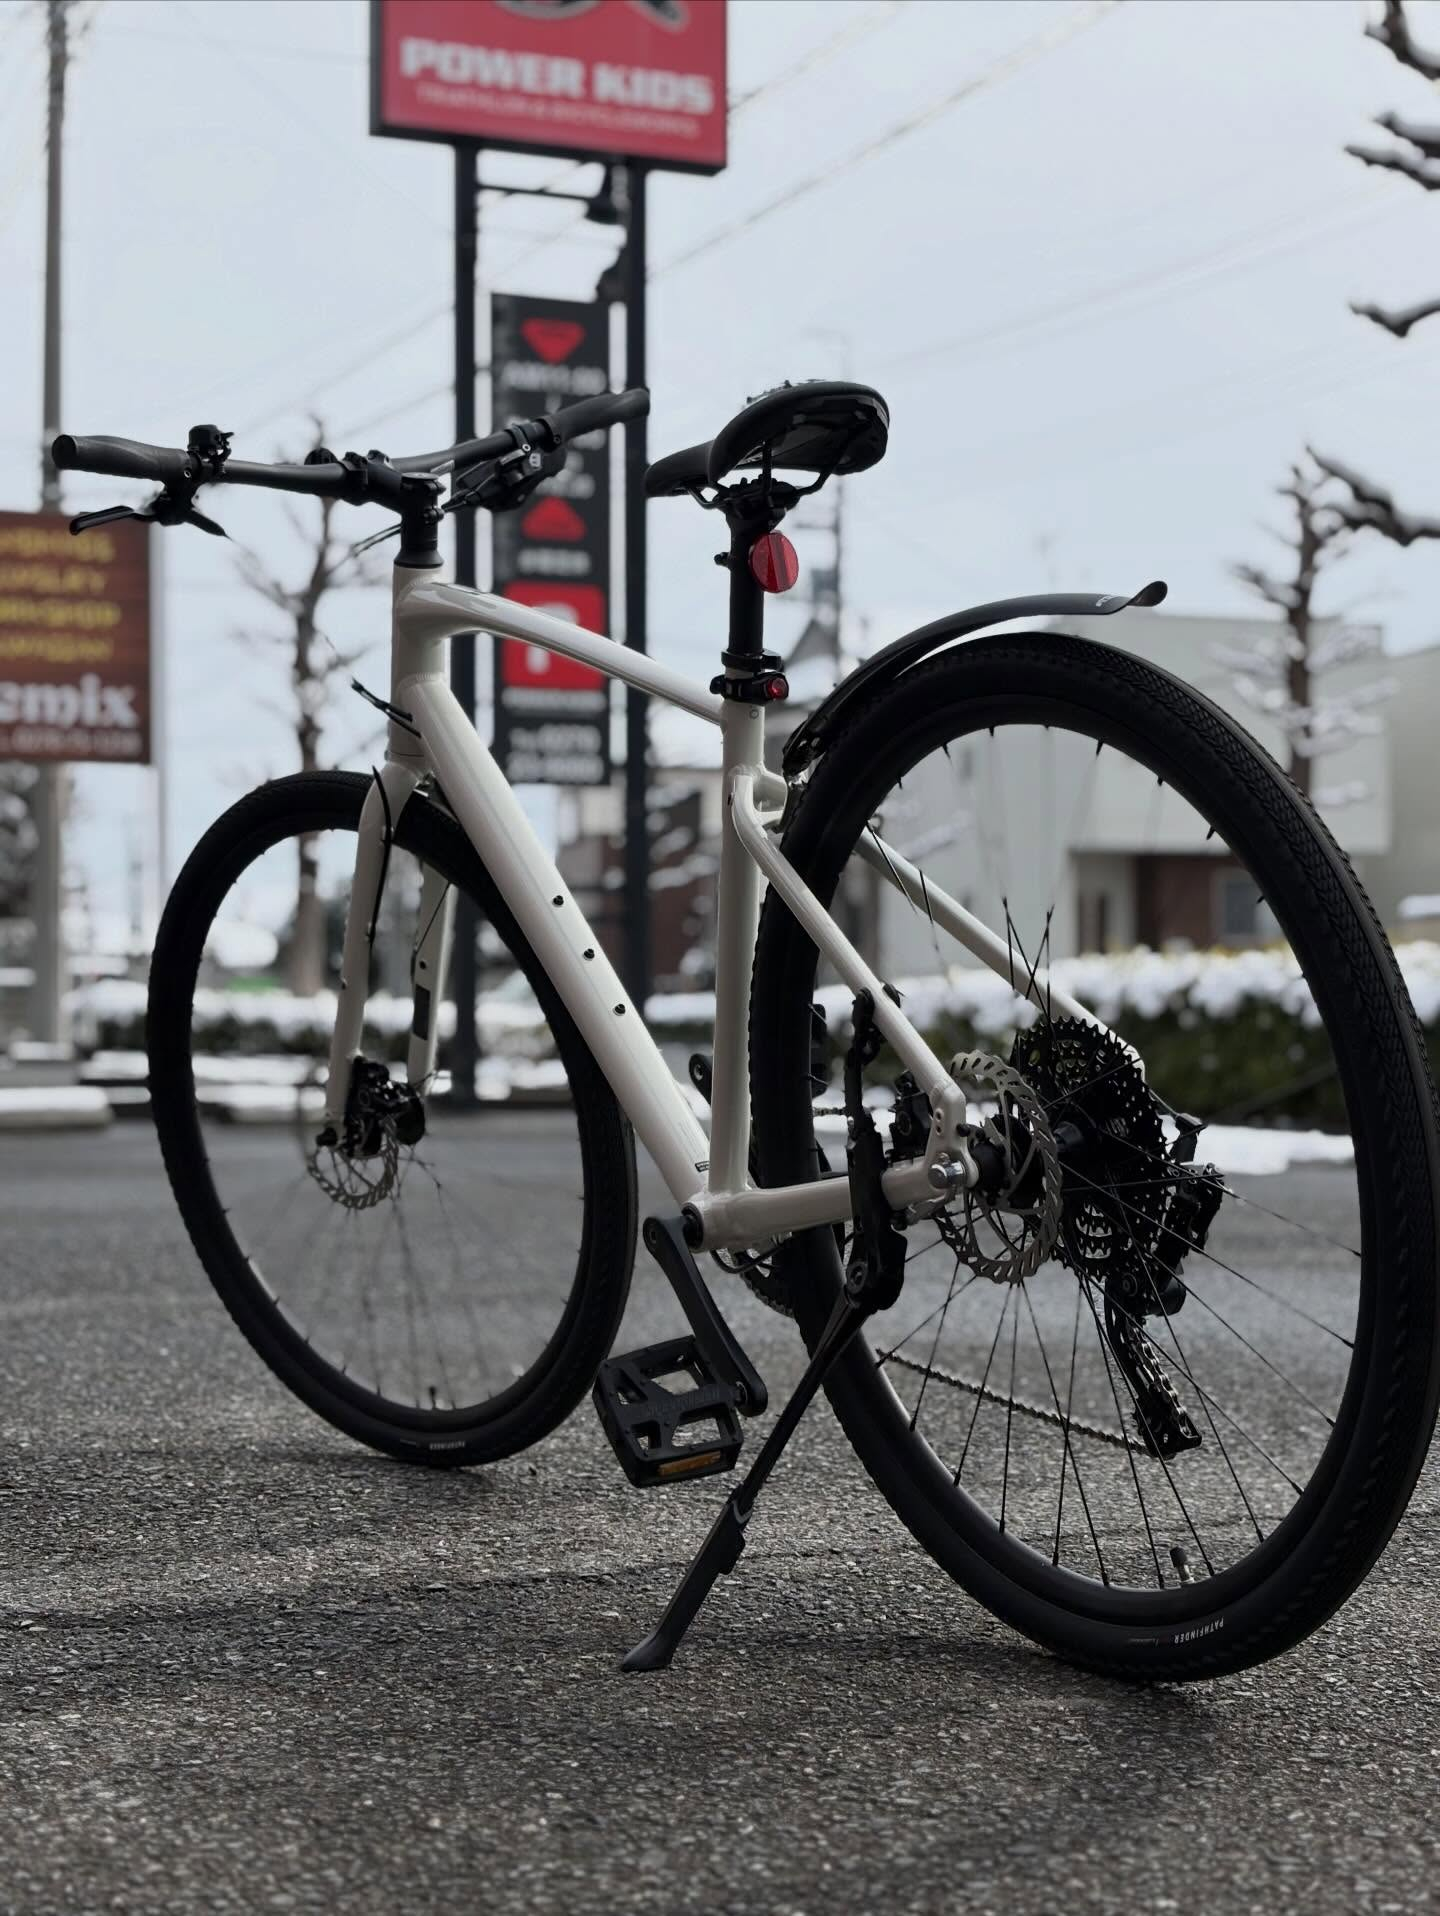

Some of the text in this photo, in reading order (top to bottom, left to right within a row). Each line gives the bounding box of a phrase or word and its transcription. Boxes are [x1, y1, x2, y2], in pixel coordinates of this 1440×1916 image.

[401, 37, 585, 98] POWER
[593, 62, 714, 115] KIDS
[1174, 1617, 1224, 1644] PATHFINDER
